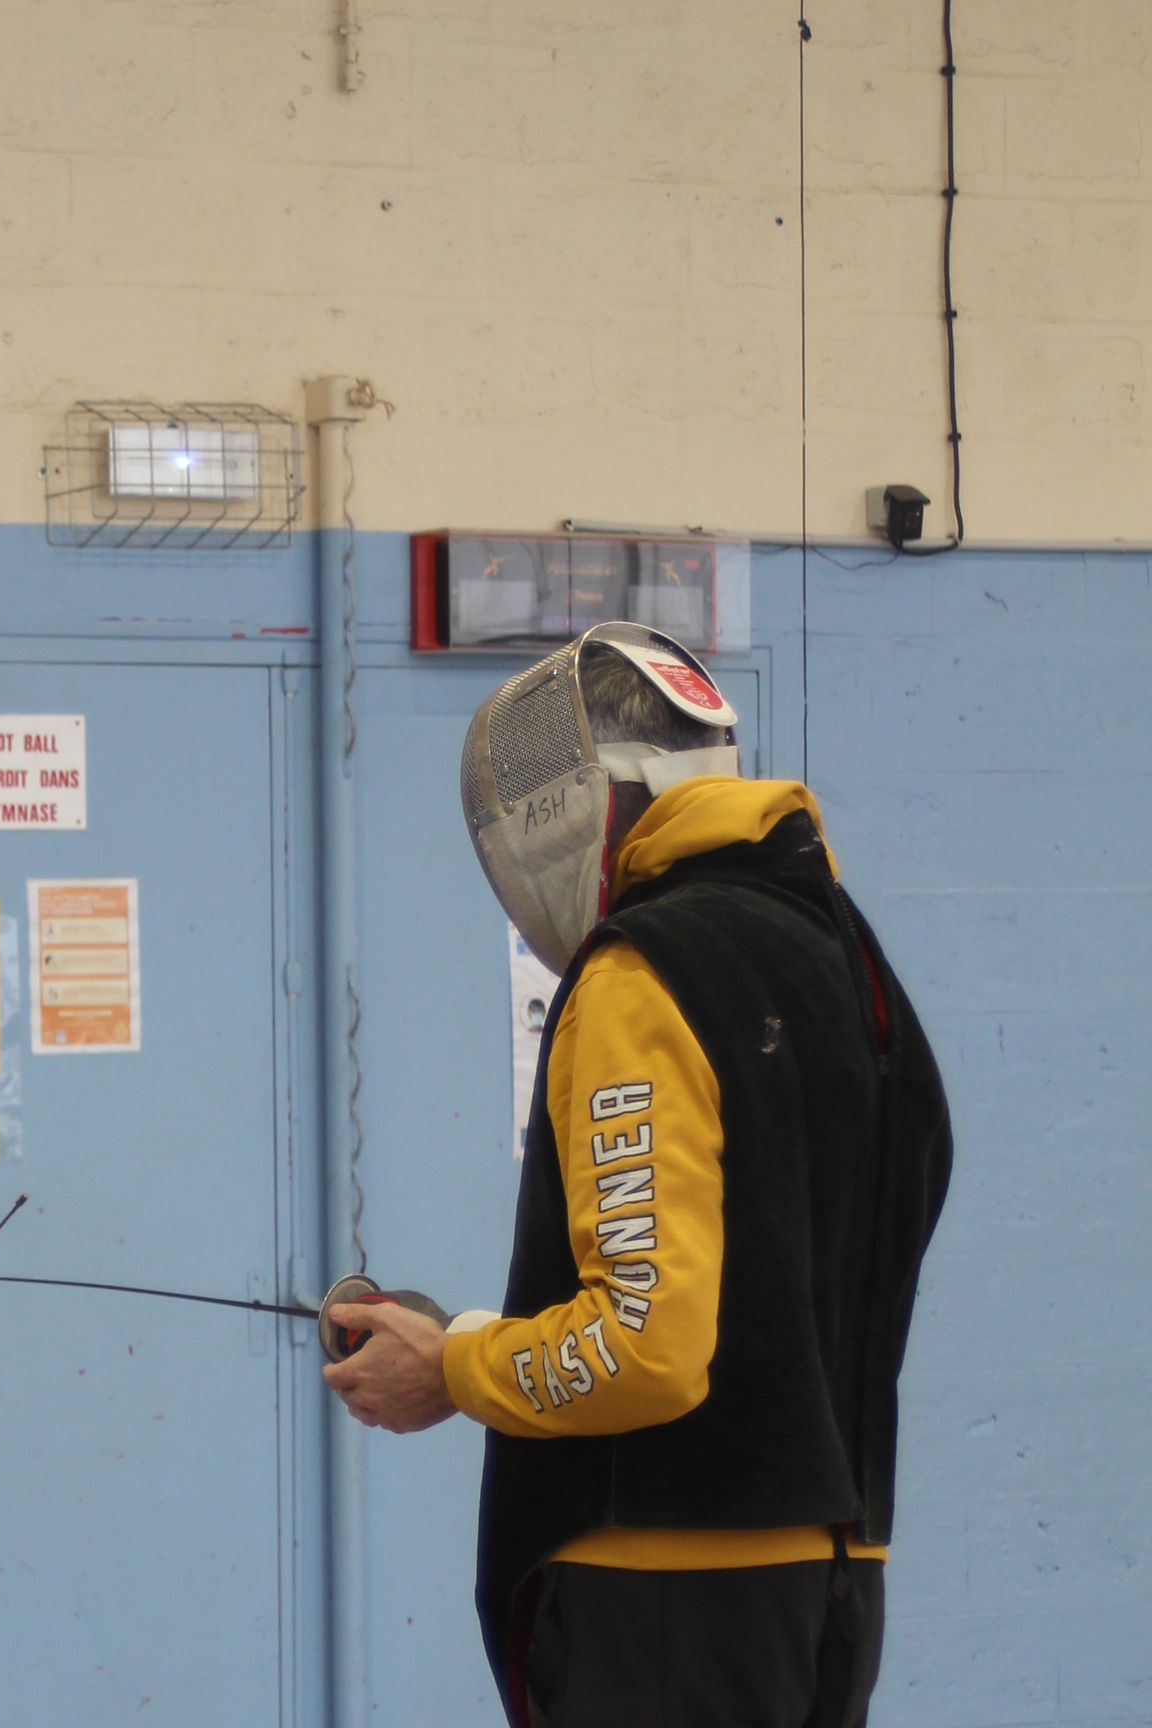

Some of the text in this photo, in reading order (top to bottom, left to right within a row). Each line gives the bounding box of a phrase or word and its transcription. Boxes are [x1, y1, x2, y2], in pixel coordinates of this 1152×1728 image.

[23, 732, 59, 753] BALL
[39, 769, 80, 789] DANS
[524, 788, 566, 835] ASH
[511, 1316, 619, 1413] FAST
